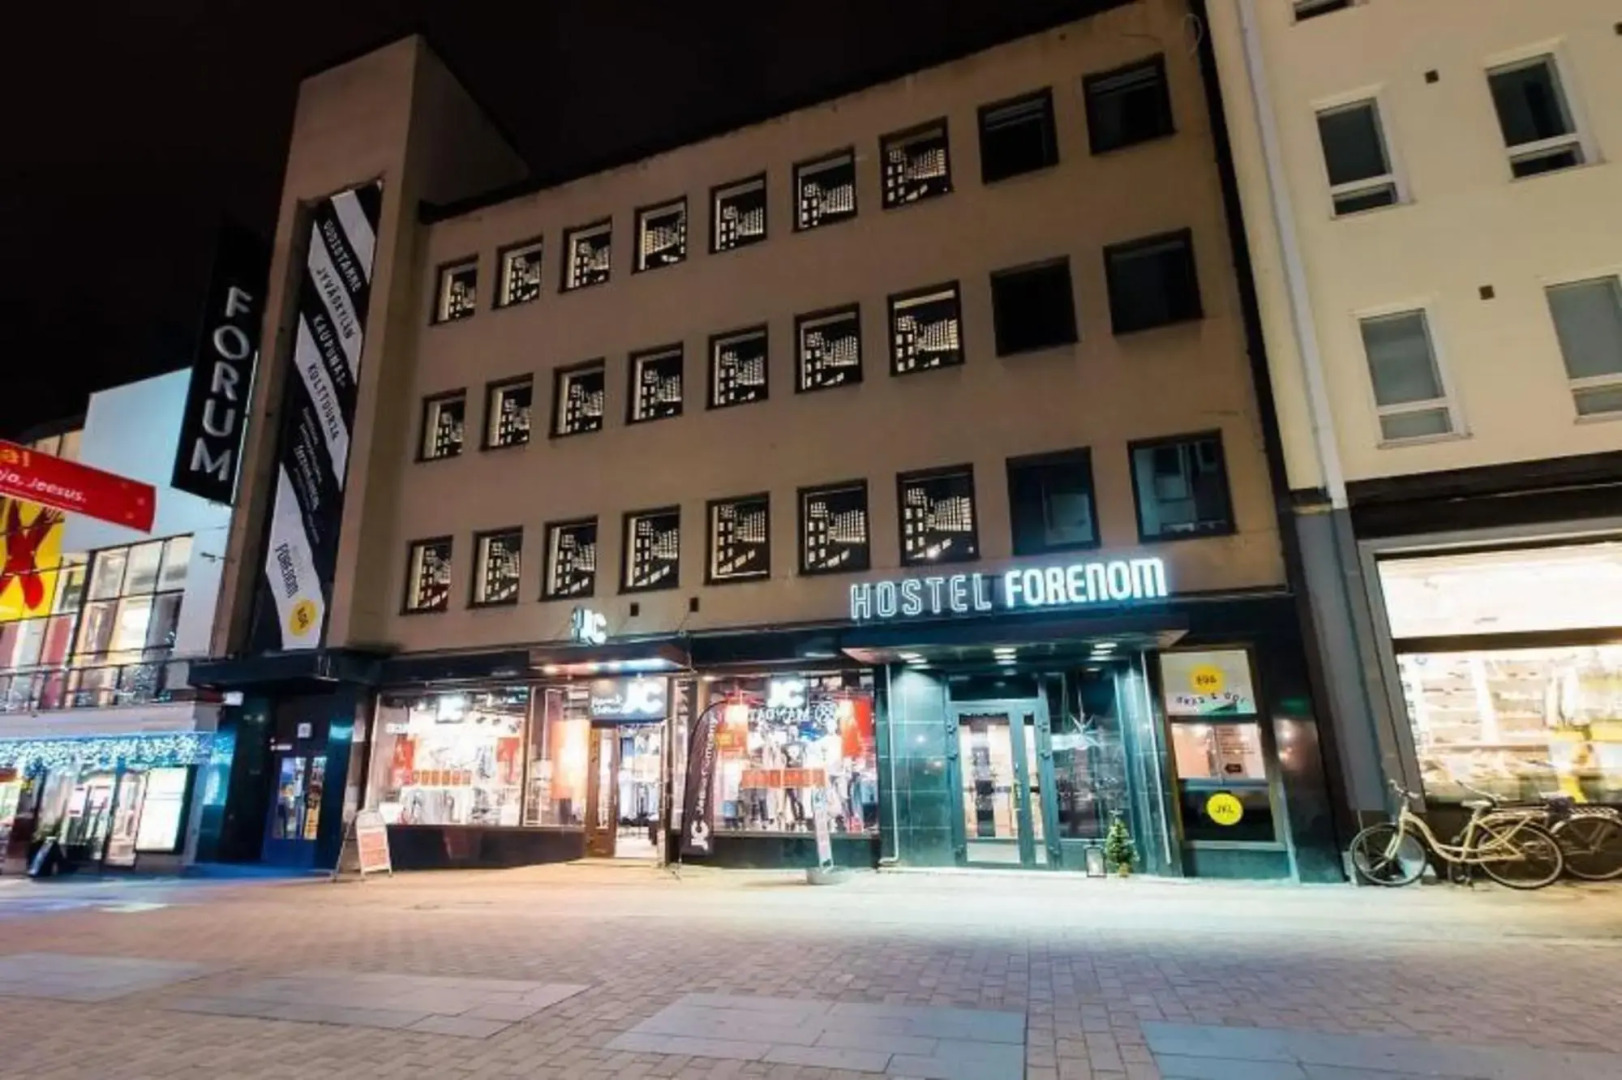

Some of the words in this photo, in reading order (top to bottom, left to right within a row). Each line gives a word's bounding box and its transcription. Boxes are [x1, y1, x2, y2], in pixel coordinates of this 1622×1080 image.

[190, 286, 252, 481] FORUM
[850, 573, 992, 620] HOSTEL
[1004, 557, 1168, 609] FORENOM
[620, 681, 664, 714] JC
[690, 820, 709, 851] JC
